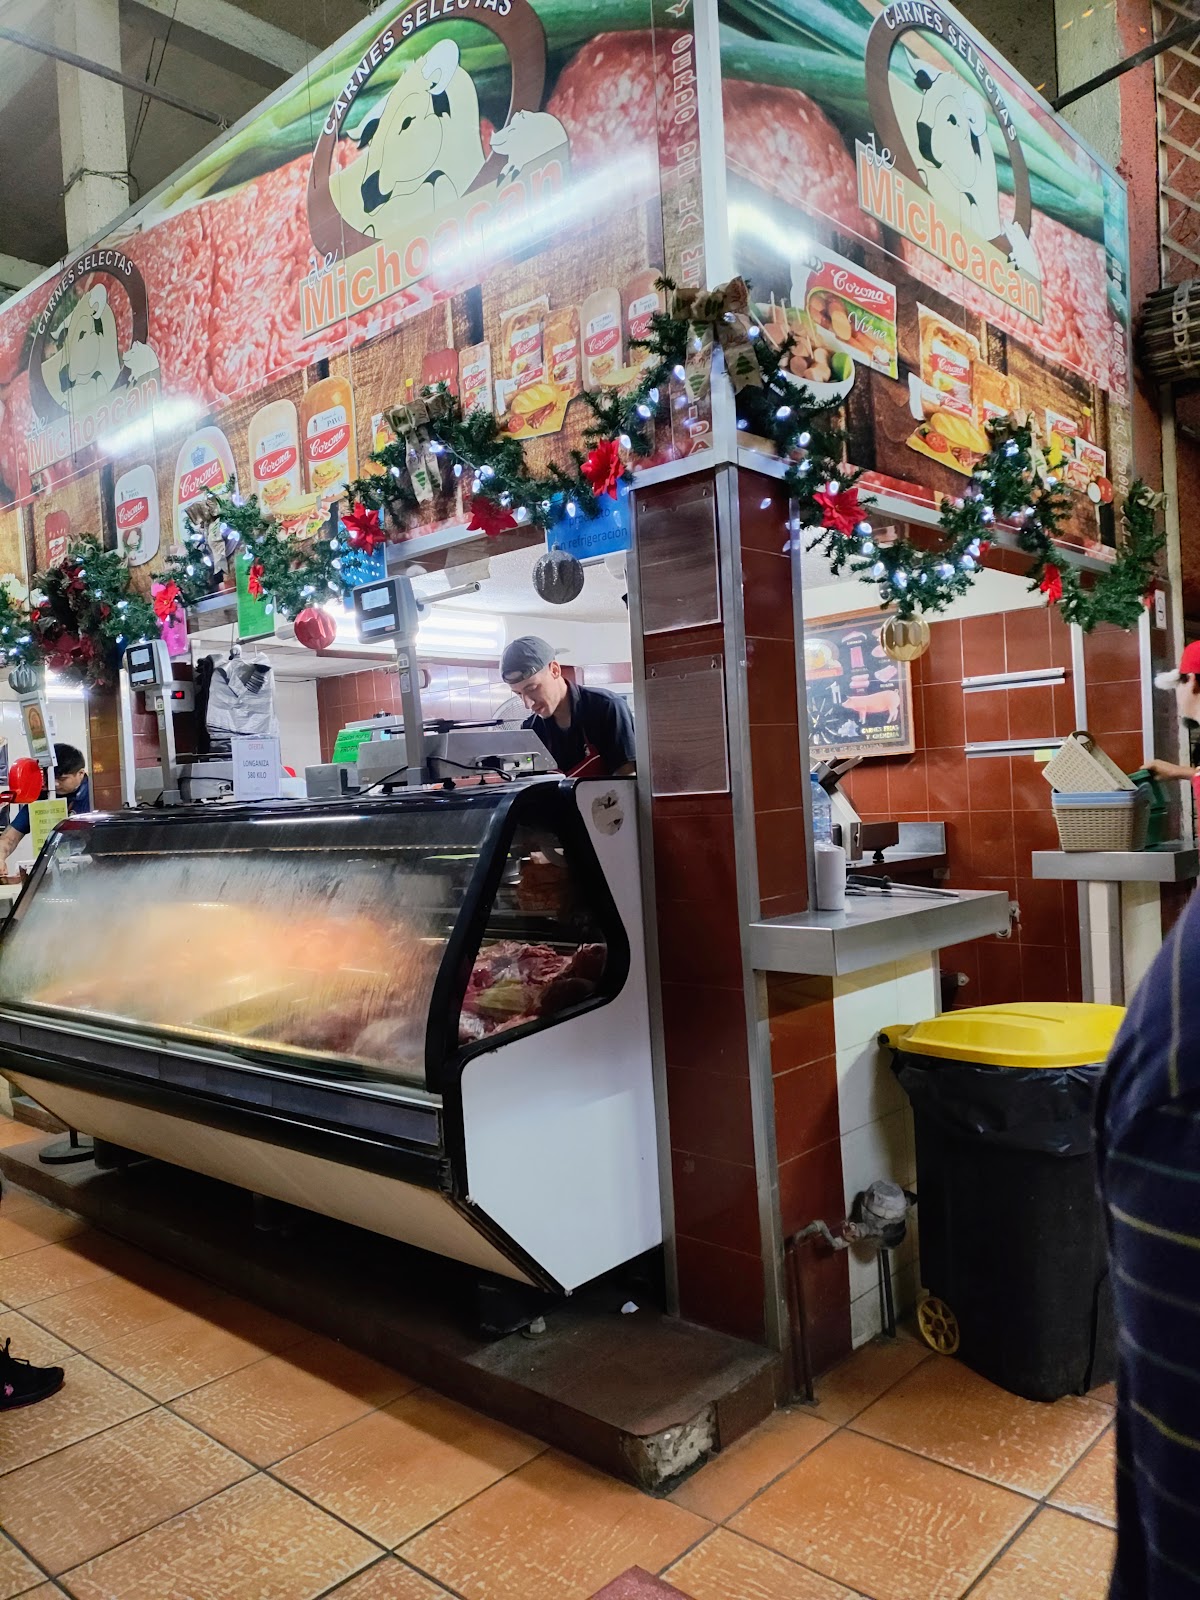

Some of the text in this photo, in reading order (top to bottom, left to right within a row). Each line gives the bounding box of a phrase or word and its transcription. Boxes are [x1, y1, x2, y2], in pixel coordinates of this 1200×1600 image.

[323, 31, 395, 135] CARNES
[671, 33, 697, 125] CERDO
[883, 2, 1017, 142] CARNES SELECTAS
[677, 141, 697, 178] DE
[864, 132, 897, 170] de
[677, 197, 702, 233] LA
[302, 158, 564, 335] Michoacan
[860, 151, 1041, 321] Michoacan
[307, 248, 338, 290] de
[830, 269, 886, 304] Corona
[38, 250, 134, 335] CARNES SELECTAS
[588, 330, 614, 353] Corona
[936, 357, 965, 375] Corona
[309, 428, 345, 457] Corona
[180, 461, 220, 499] Corona
[258, 450, 291, 477] Corona
[118, 501, 144, 524] Corona
[568, 527, 628, 549] refrigeración
[257, 771, 267, 779] KILO
